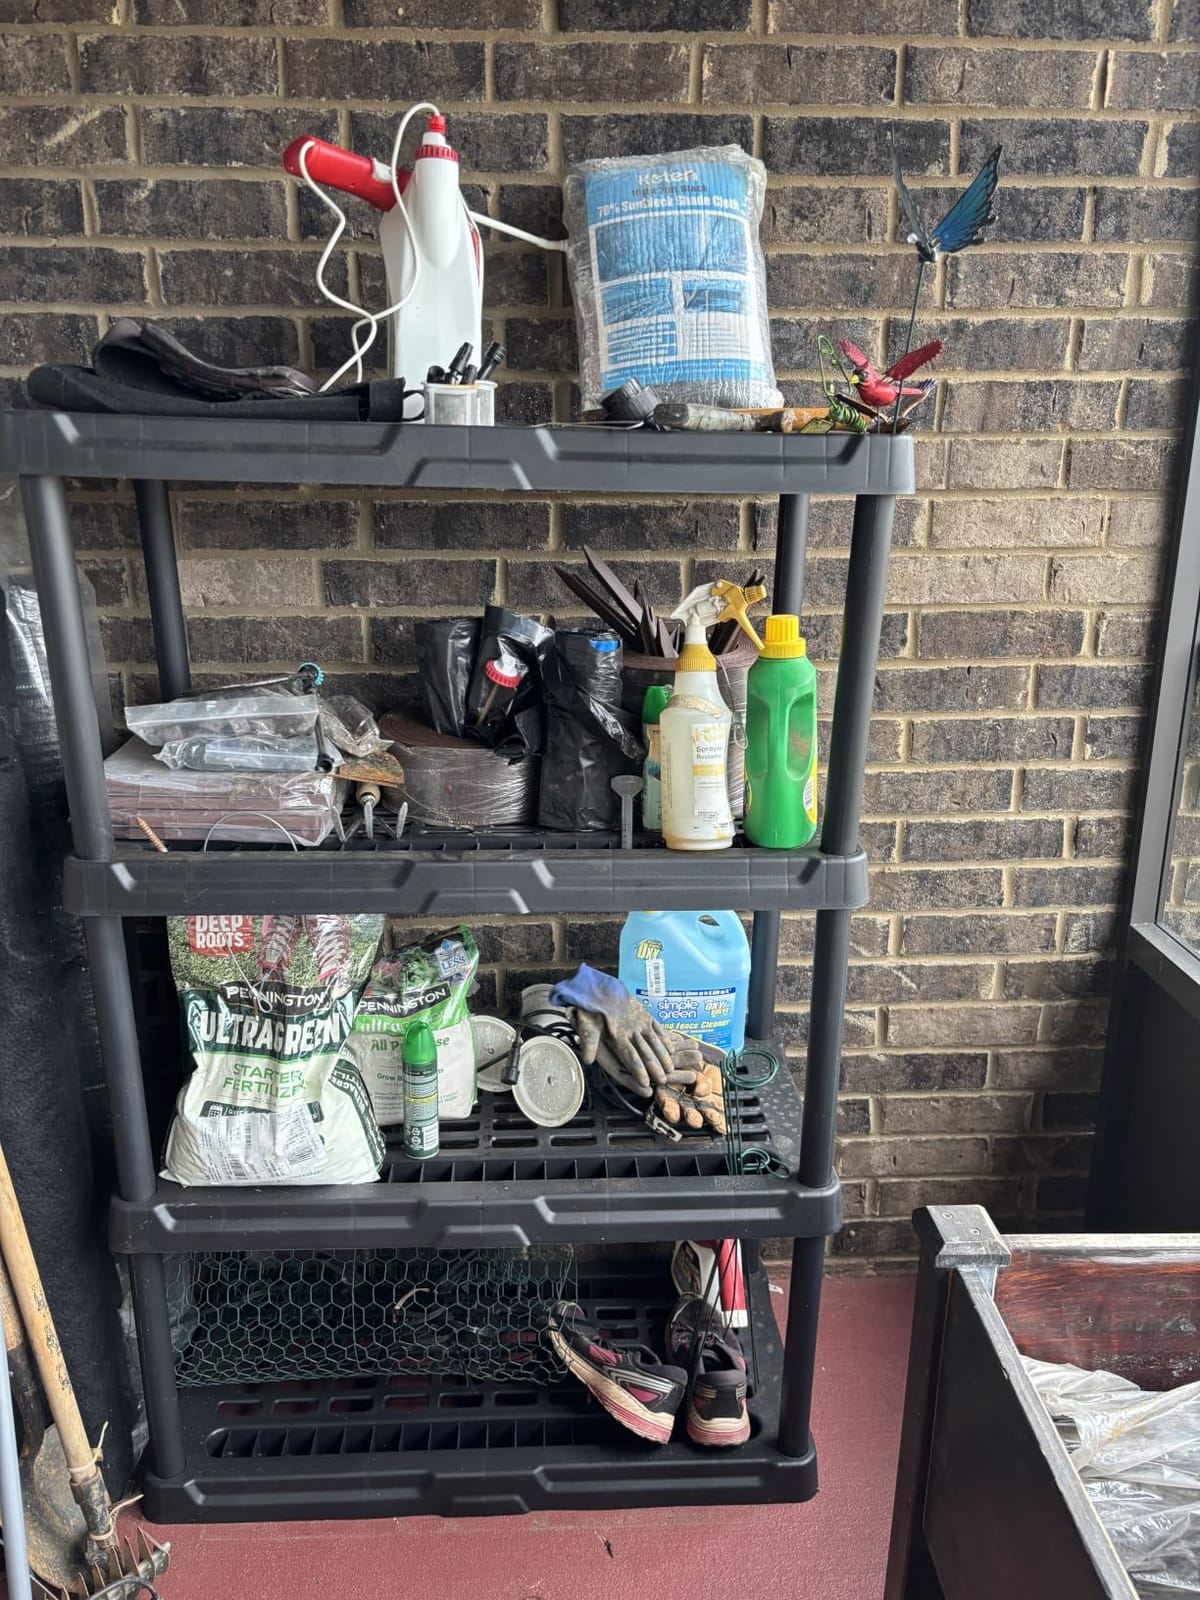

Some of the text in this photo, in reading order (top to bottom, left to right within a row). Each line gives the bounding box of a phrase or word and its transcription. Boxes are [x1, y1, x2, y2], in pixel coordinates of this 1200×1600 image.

[713, 195, 740, 210] Cloth
[196, 915, 243, 931] DEEP
[196, 932, 244, 948] ROOTS
[359, 988, 446, 1014] PENNINGTON
[657, 999, 699, 1011] simple
[658, 1009, 697, 1021] green
[200, 1011, 340, 1055] ULTRAGREEN
[371, 1039, 387, 1051] All
[233, 1063, 303, 1084] STARTER
[377, 1072, 395, 1081] Grow
